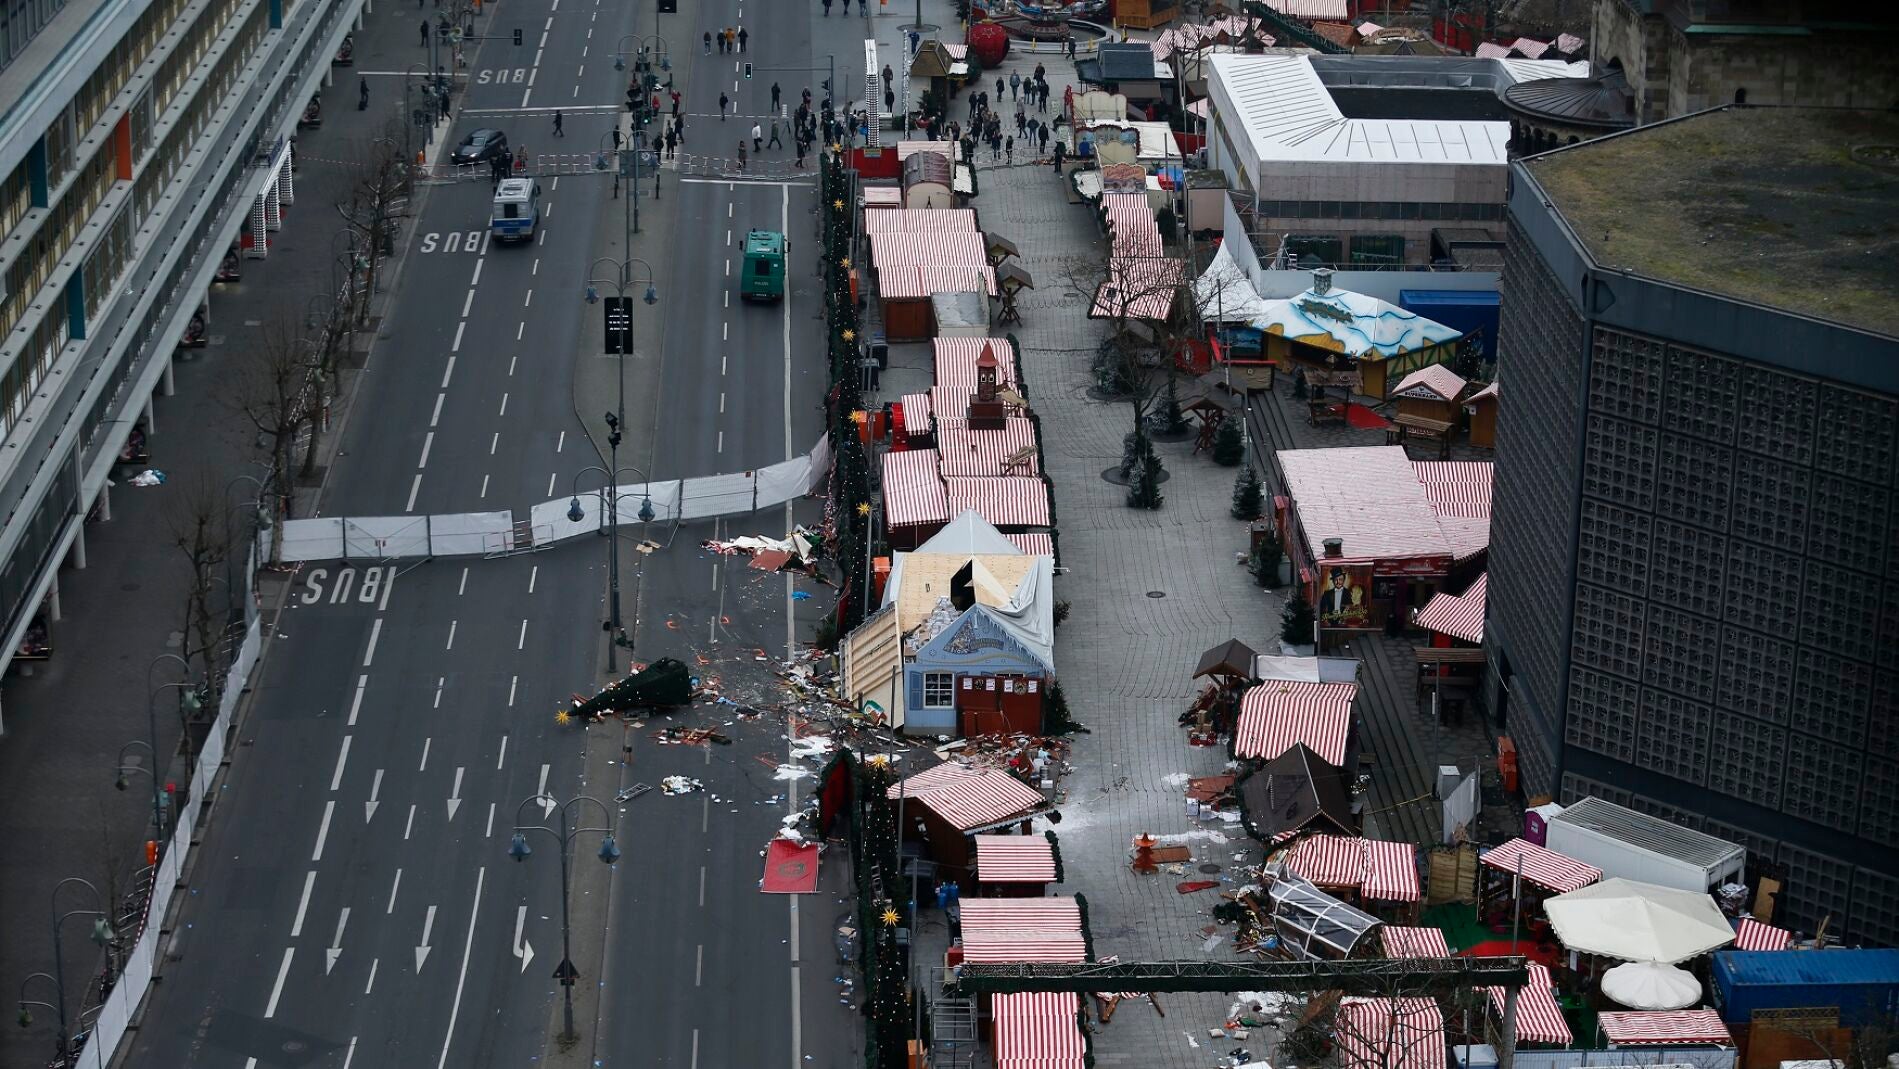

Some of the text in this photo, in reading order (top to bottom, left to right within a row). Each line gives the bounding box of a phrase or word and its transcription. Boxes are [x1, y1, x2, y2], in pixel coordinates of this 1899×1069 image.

[477, 68, 526, 84] BUS
[420, 231, 482, 253] BUS
[301, 566, 382, 605] BUS
